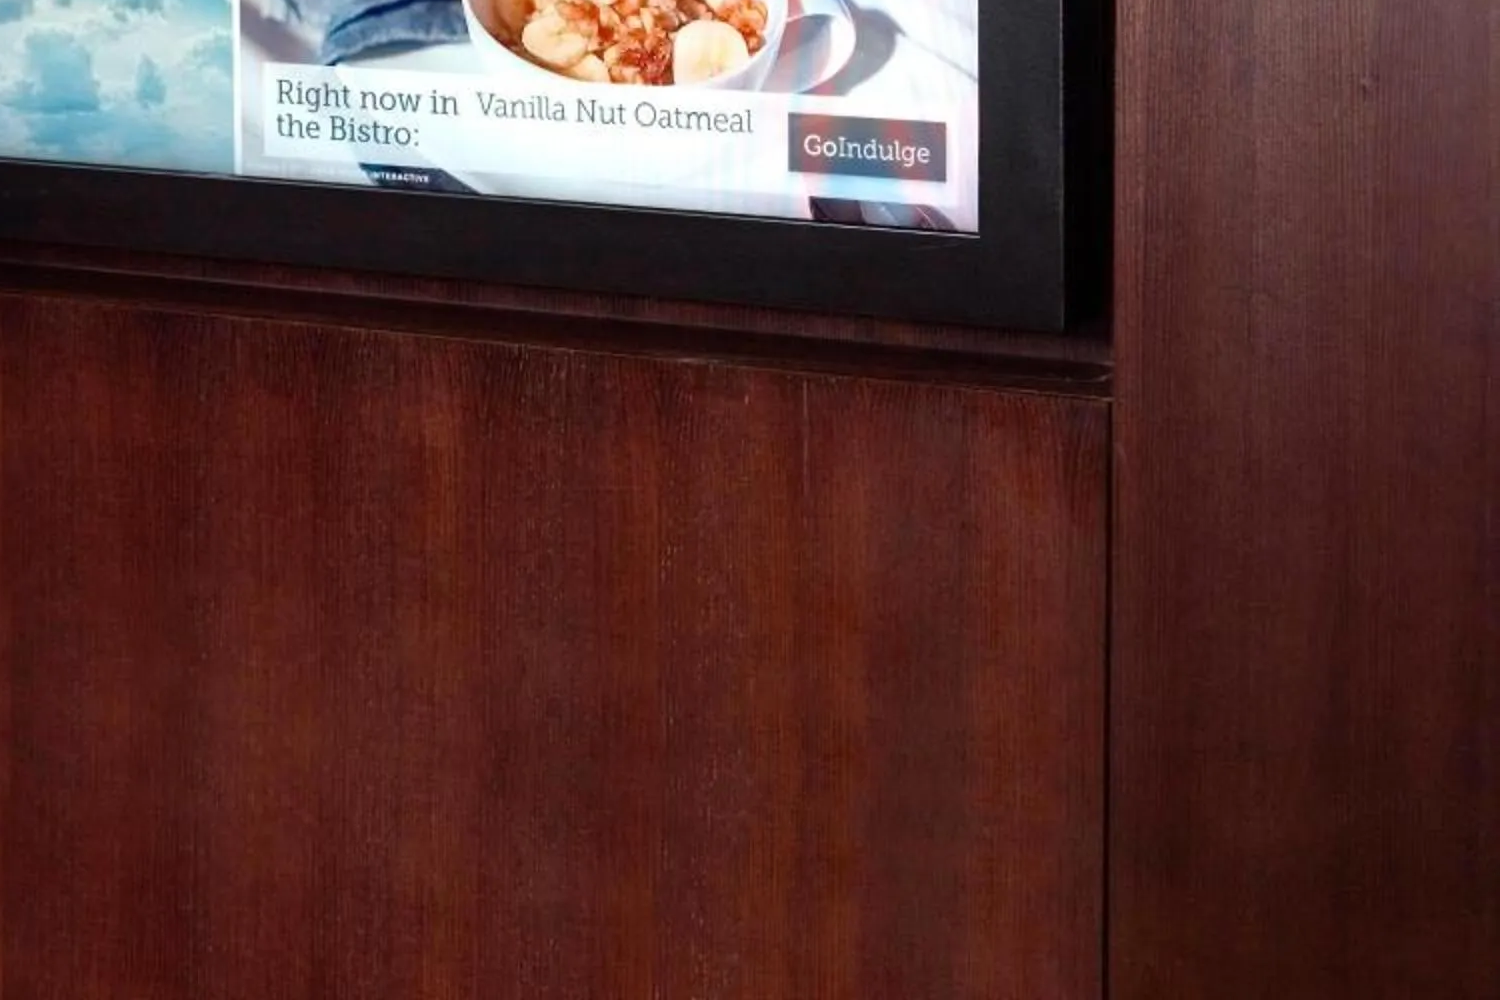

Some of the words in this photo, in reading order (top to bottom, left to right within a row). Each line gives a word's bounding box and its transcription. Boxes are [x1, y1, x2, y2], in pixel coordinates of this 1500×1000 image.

[276, 79, 351, 113] Right
[360, 89, 422, 113] now
[430, 89, 459, 116] in
[476, 90, 567, 122] Vanilla
[575, 98, 627, 126] Nut
[634, 101, 754, 134] Oatmeal
[276, 113, 321, 139] the
[330, 115, 420, 147] Bistro:
[803, 134, 931, 168] GoIndulge
